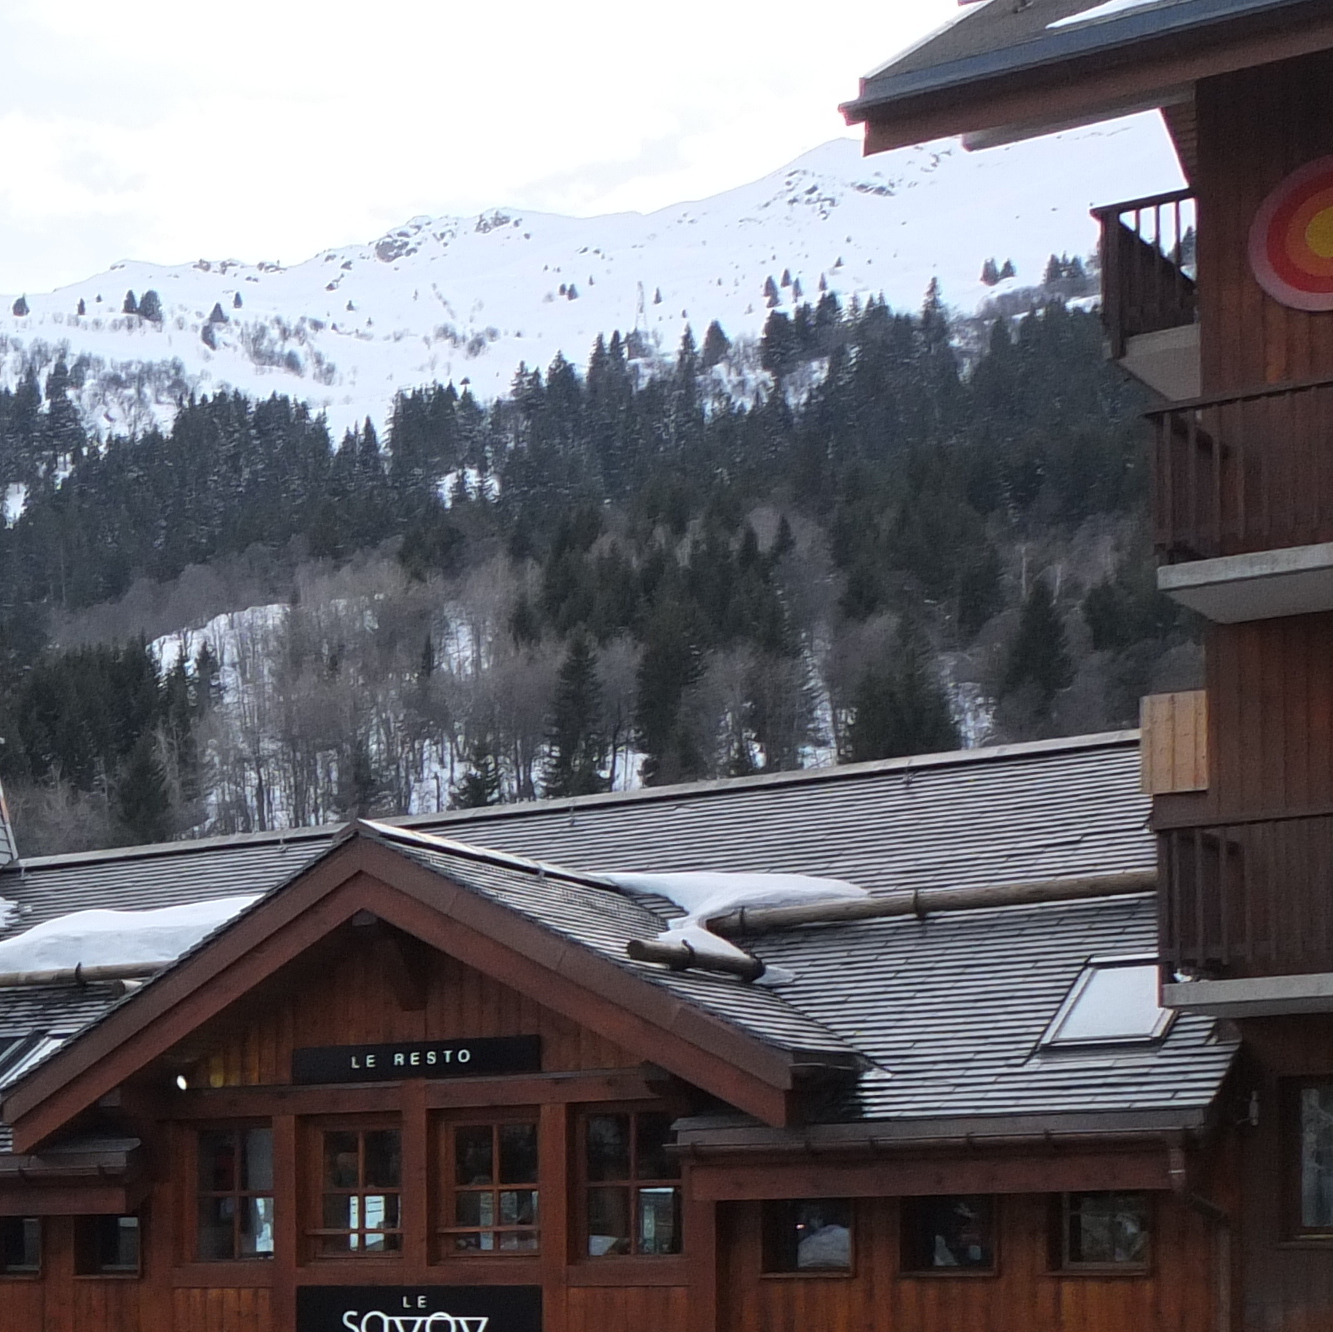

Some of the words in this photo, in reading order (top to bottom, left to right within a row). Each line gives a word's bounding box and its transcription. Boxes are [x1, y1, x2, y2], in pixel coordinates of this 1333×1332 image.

[351, 1055, 376, 1069] LE
[393, 1049, 471, 1066] RESTO
[402, 1295, 427, 1308] LE
